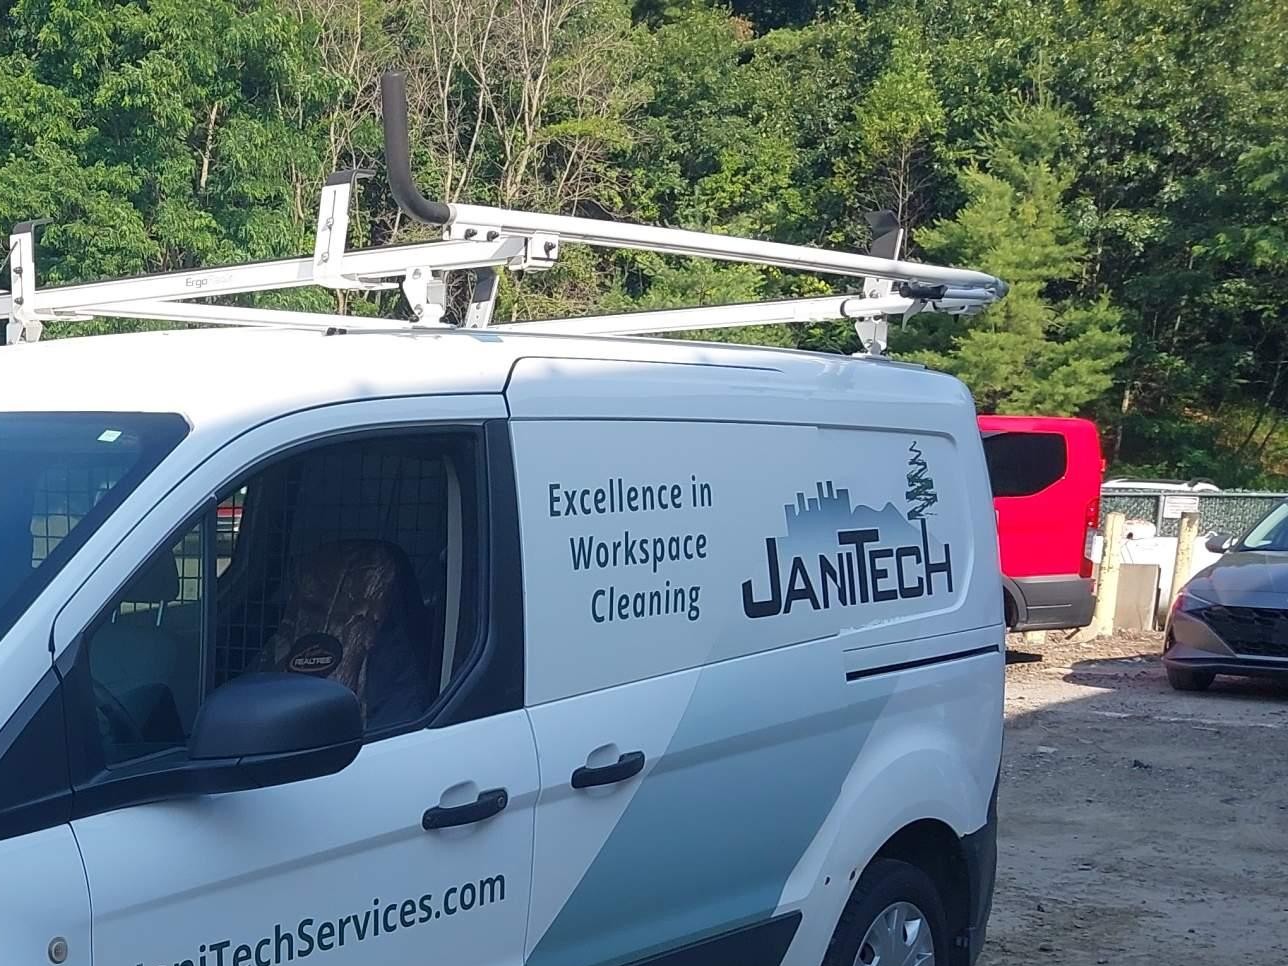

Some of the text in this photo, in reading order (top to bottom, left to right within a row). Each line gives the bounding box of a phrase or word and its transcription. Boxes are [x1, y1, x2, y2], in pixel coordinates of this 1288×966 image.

[548, 474, 713, 517] Excellence in
[569, 531, 708, 573] Workspace
[591, 580, 701, 623] Cleaning
